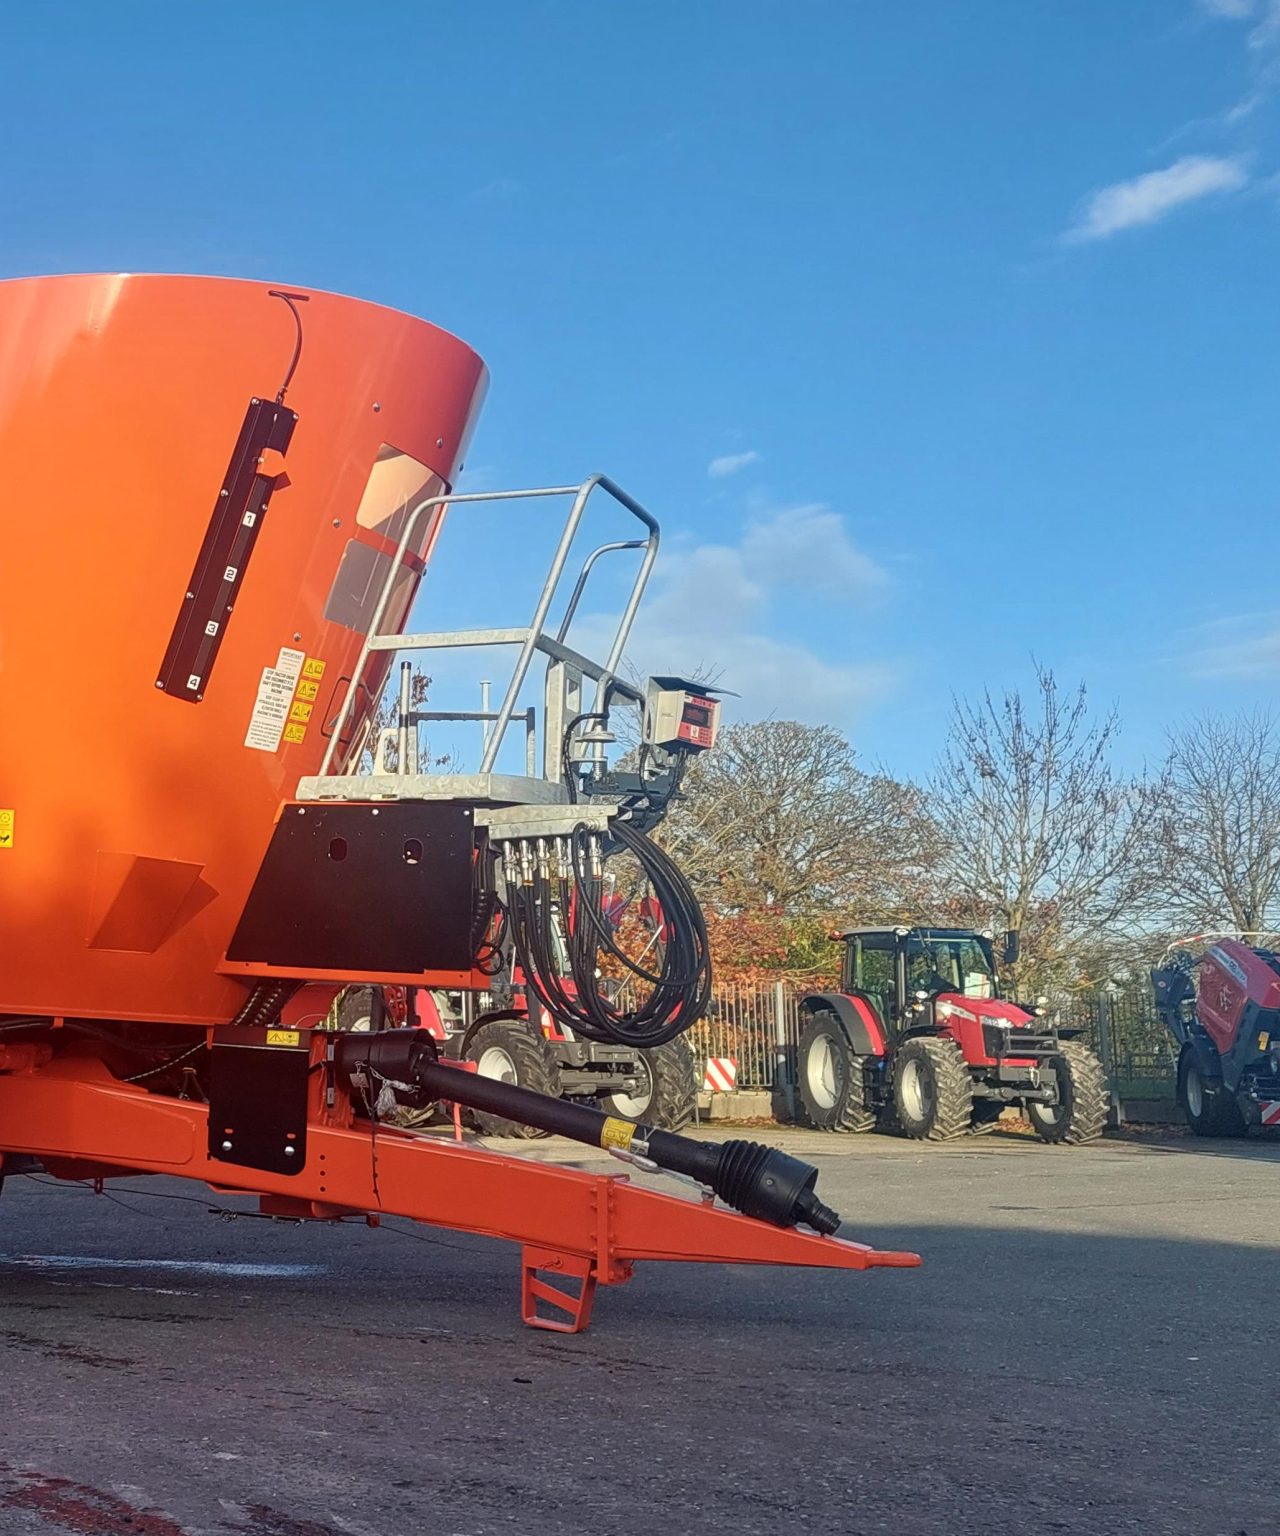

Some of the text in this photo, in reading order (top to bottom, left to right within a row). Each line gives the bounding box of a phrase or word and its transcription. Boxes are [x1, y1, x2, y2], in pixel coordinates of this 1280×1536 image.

[245, 513, 254, 525] 1
[225, 569, 235, 579] 2
[206, 623, 217, 634] 3
[189, 677, 198, 688] 4
